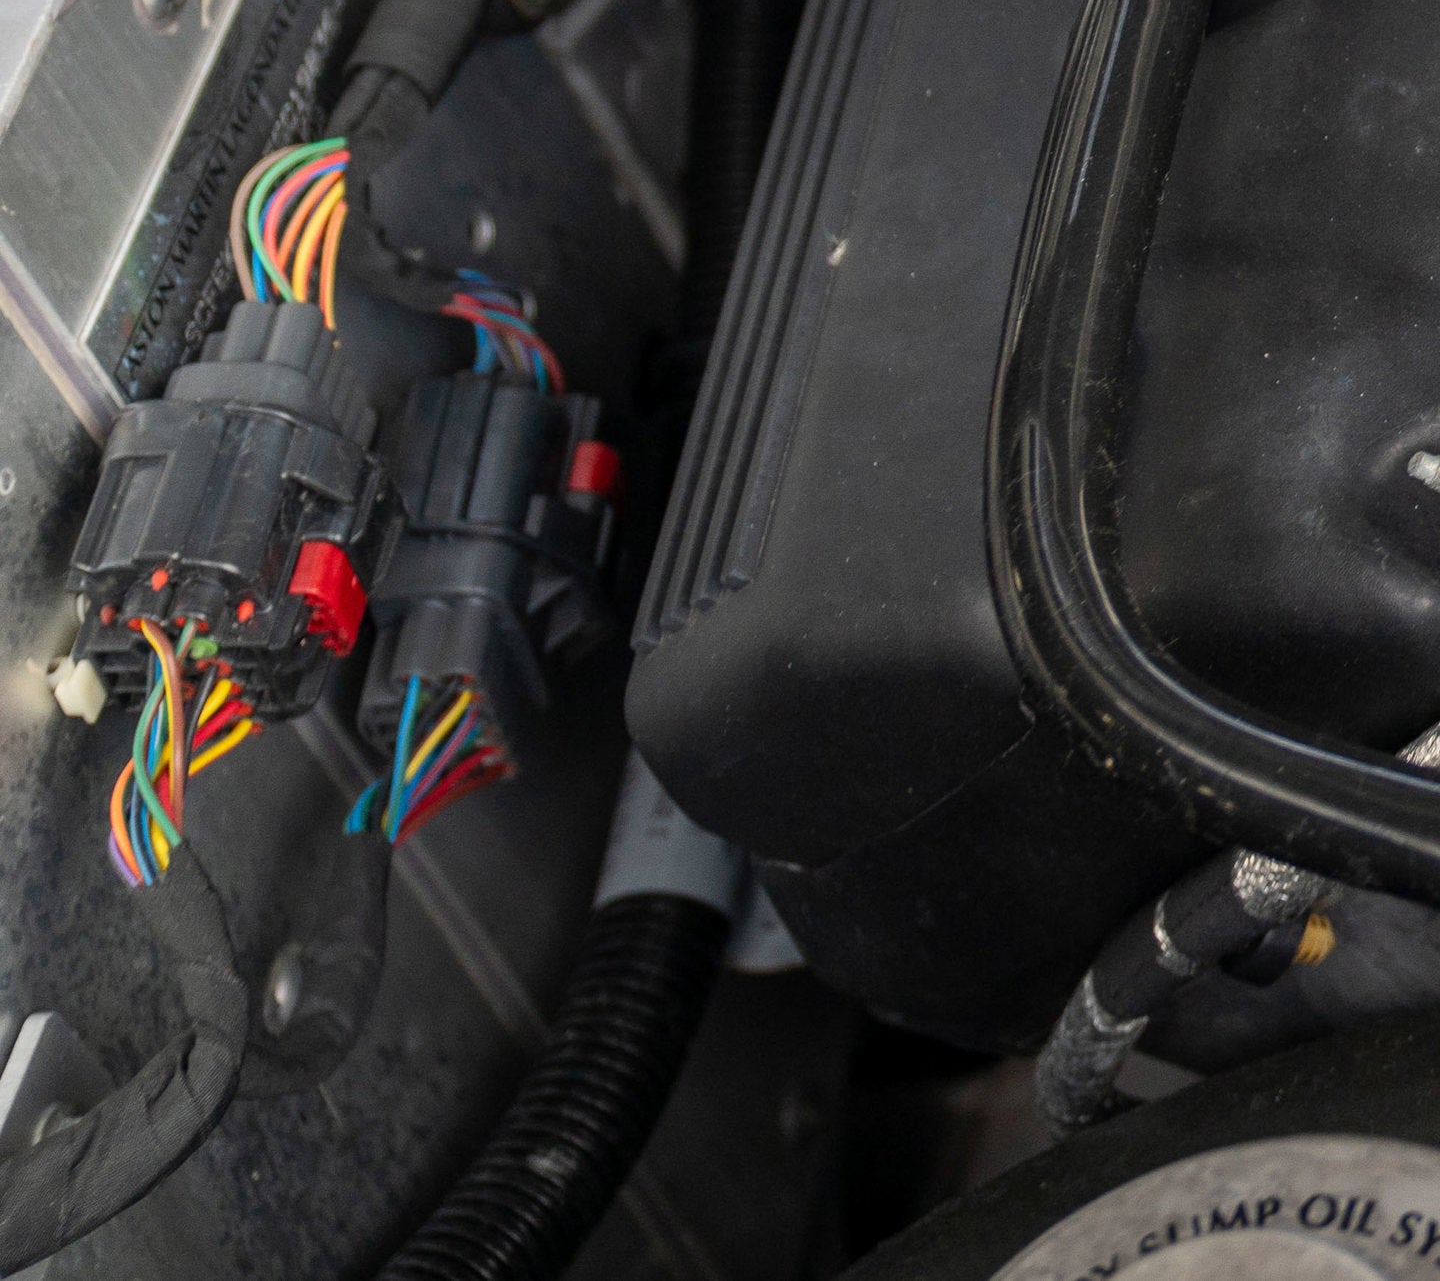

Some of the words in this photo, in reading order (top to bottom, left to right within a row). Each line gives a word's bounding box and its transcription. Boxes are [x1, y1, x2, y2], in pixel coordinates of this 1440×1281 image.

[123, 274, 178, 374] ASTON
[169, 161, 229, 268] MARTIN
[217, 12, 291, 160] LAGONDA
[1299, 1193, 1377, 1236] OIL
